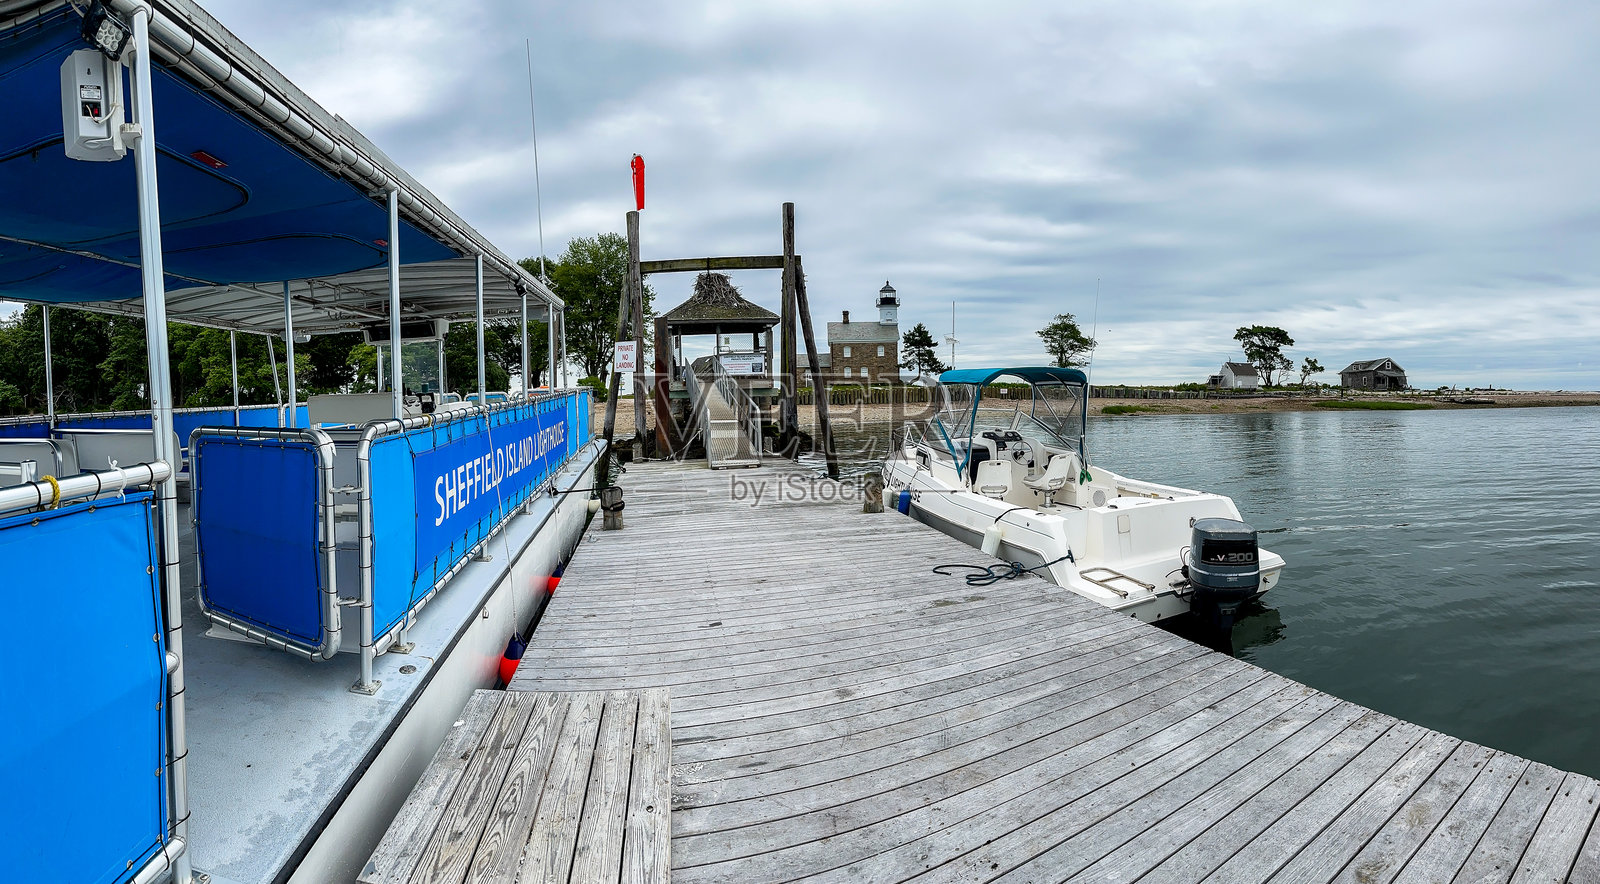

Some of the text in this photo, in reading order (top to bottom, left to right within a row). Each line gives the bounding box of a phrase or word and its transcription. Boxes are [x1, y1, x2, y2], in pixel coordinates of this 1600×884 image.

[617, 344, 634, 352] PRIVATE
[622, 353, 629, 361] NO
[435, 420, 565, 526] SHEFFIELD ISLAND LIGHTHOUSE
[1228, 552, 1254, 562] 200
